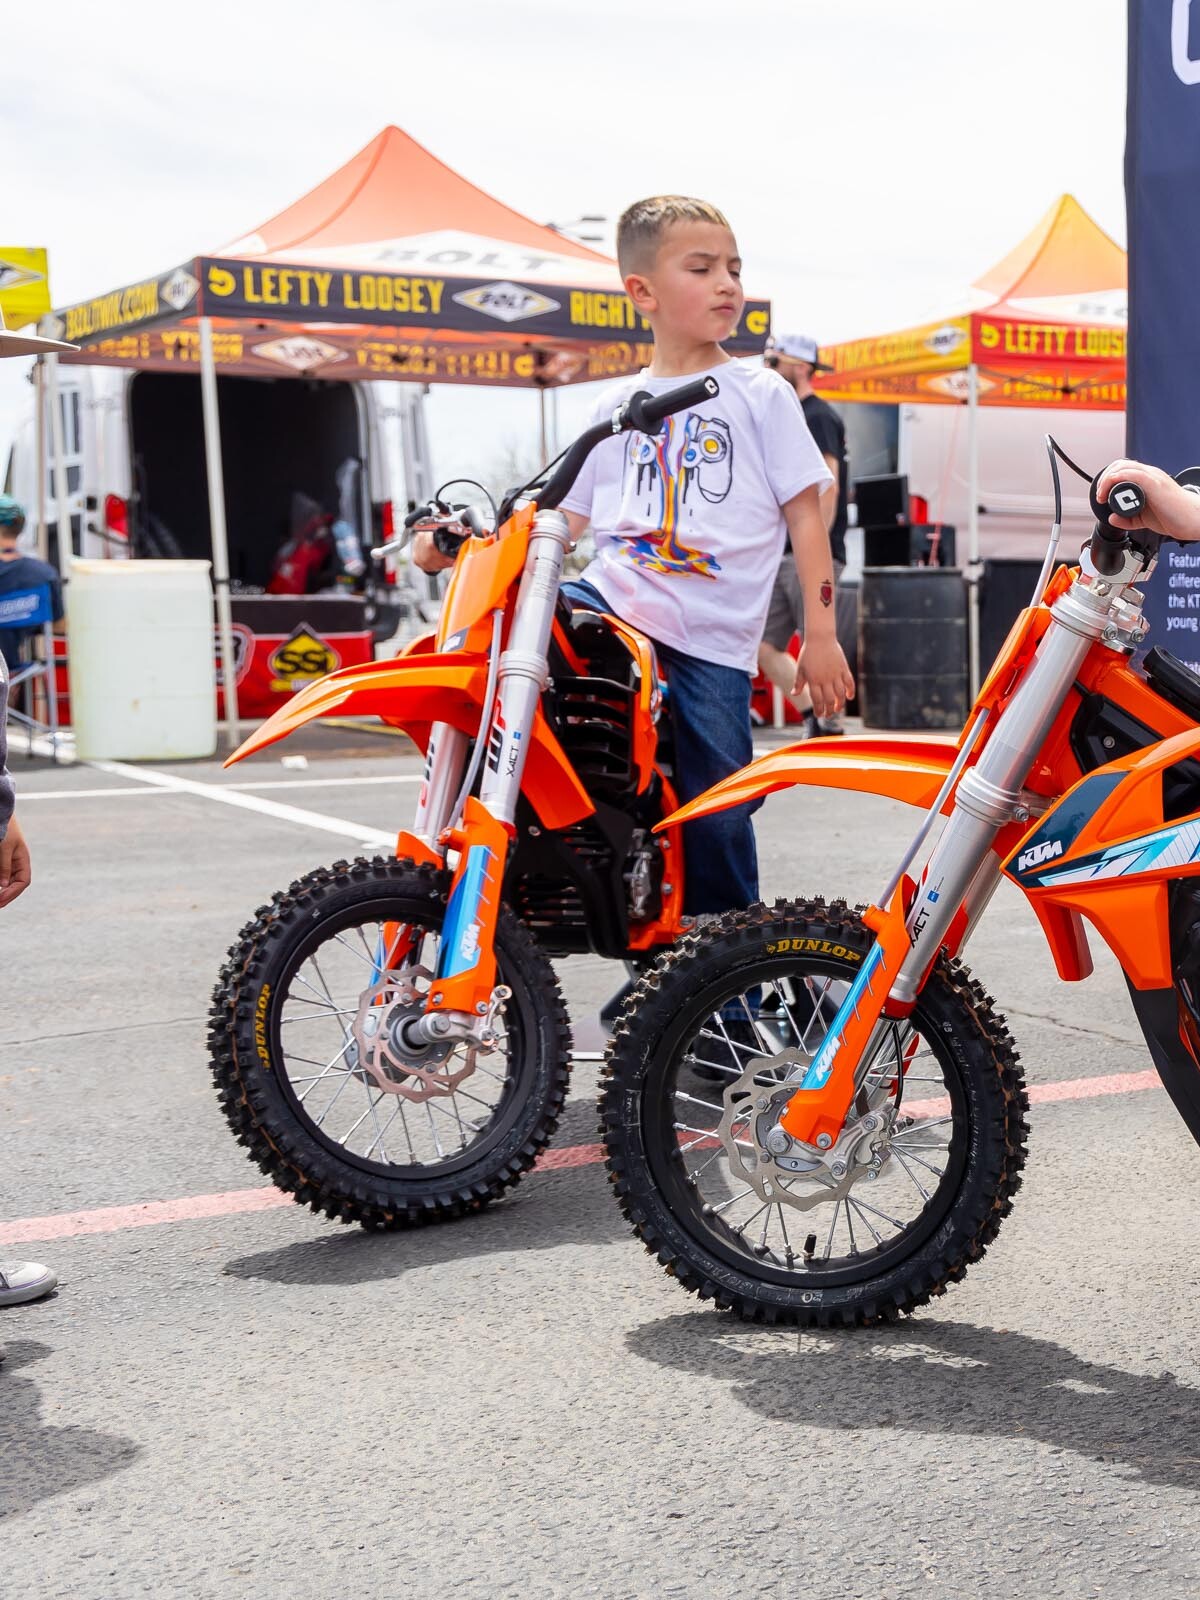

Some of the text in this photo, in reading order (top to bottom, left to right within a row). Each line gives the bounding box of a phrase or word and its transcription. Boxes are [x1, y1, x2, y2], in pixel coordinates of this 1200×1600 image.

[242, 266, 444, 314] LEFTY LOOSEY
[570, 291, 650, 330] RIGHT
[1005, 323, 1127, 358] LEFTY LOOS
[1168, 595, 1186, 609] the
[1167, 618, 1198, 632] young
[1018, 840, 1063, 872] KTM
[461, 923, 481, 961] KTM
[777, 938, 861, 962] DUNLOP
[255, 984, 272, 1060] DUNLOP
[815, 1035, 842, 1082] KTM
